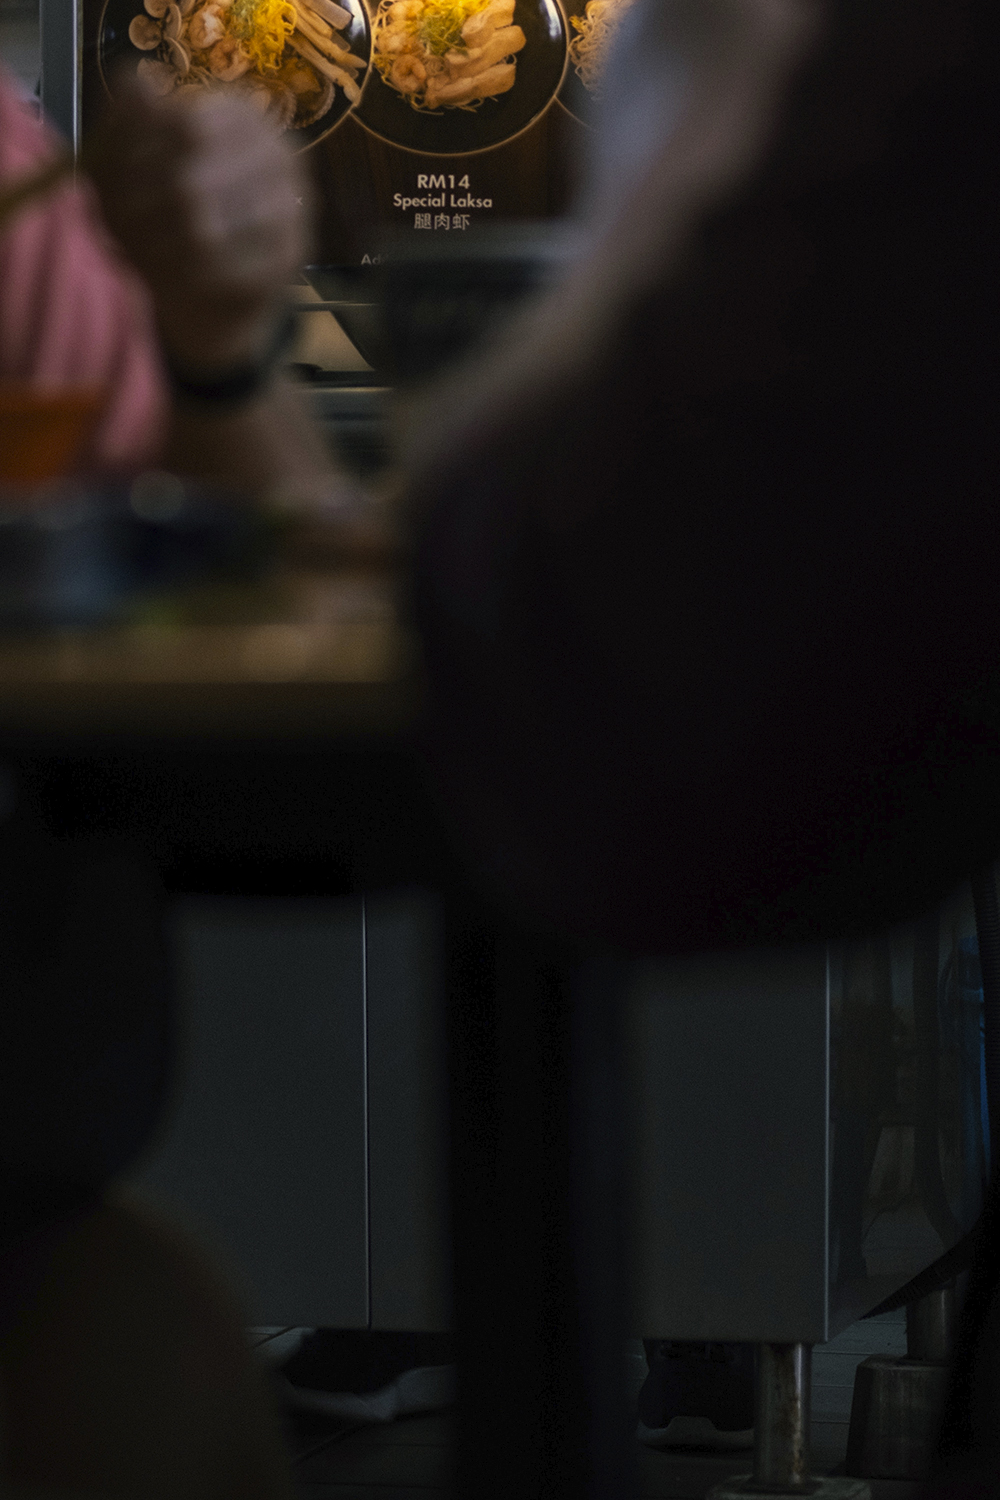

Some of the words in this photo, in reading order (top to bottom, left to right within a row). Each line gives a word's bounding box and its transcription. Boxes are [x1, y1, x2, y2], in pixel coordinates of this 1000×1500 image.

[417, 174, 470, 189] RM14
[393, 193, 446, 211] Special
[450, 193, 493, 208] Laksa
[413, 212, 471, 230] 腿肉虾
